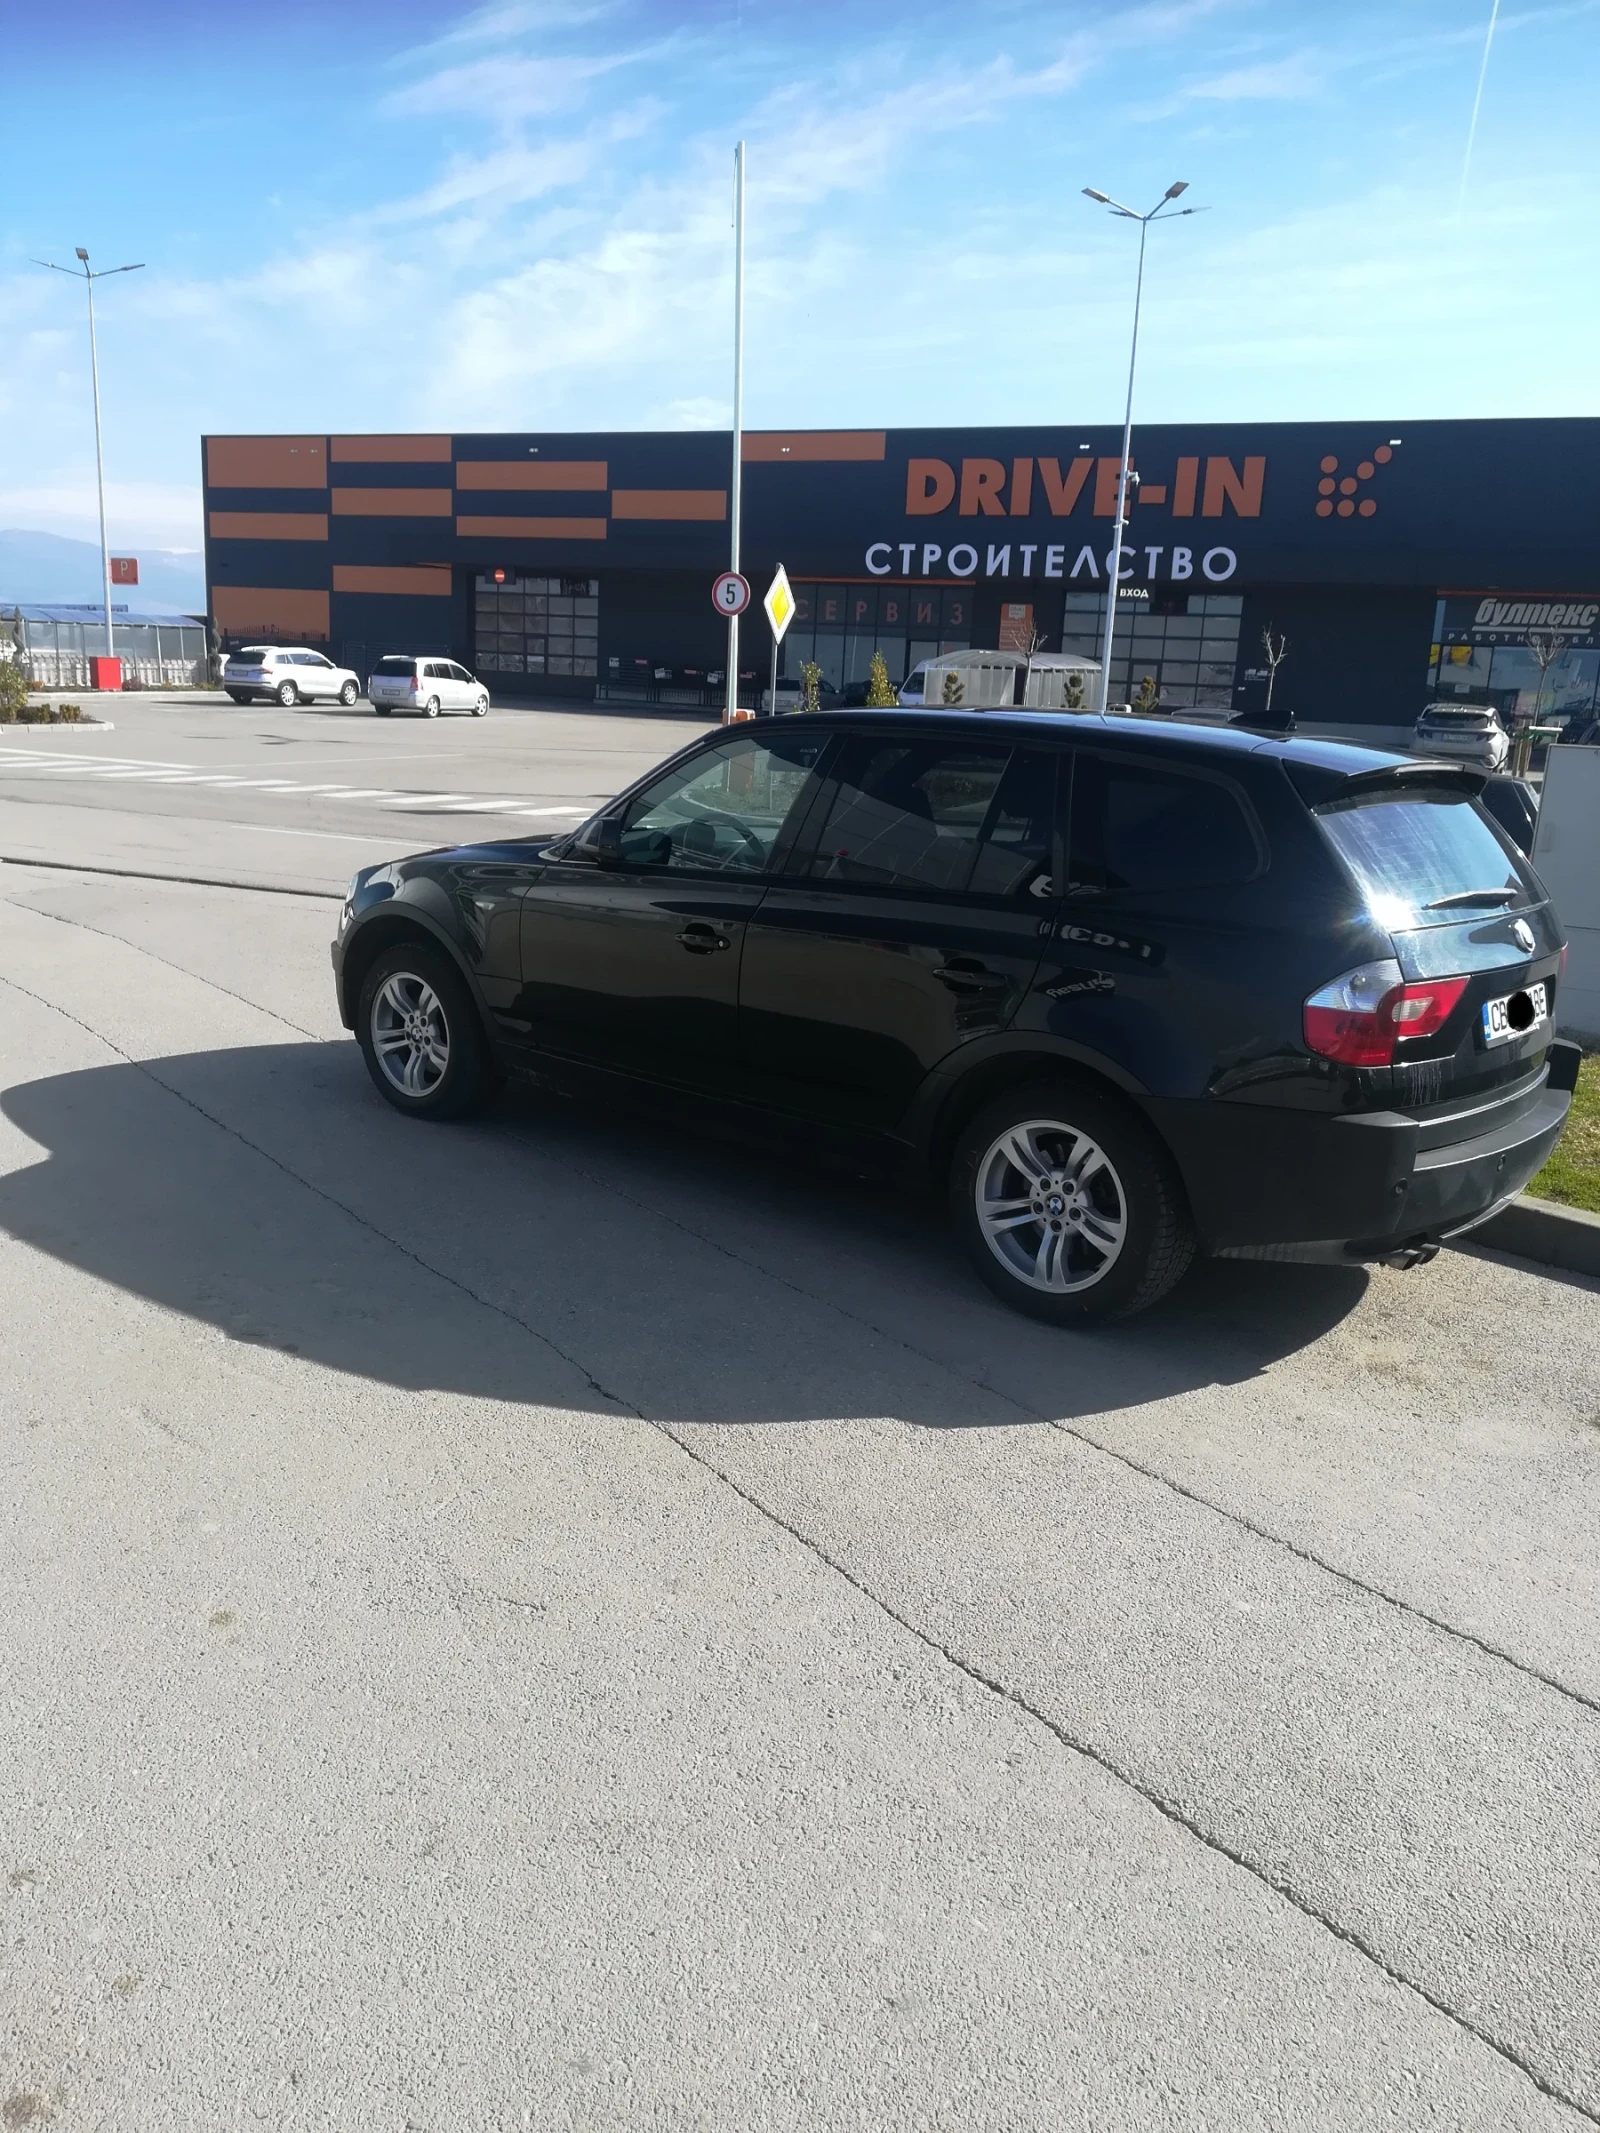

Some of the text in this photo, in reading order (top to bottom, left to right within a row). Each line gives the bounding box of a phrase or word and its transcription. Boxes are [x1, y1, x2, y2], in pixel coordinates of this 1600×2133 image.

[905, 456, 1266, 517] DRIVE-IN
[120, 560, 128, 577] P
[865, 542, 1237, 581] СТРОИТЕЛСТВО
[725, 583, 736, 605] 5
[1119, 588, 1149, 599] ВХОД
[794, 598, 964, 625] СЕРВИЗ
